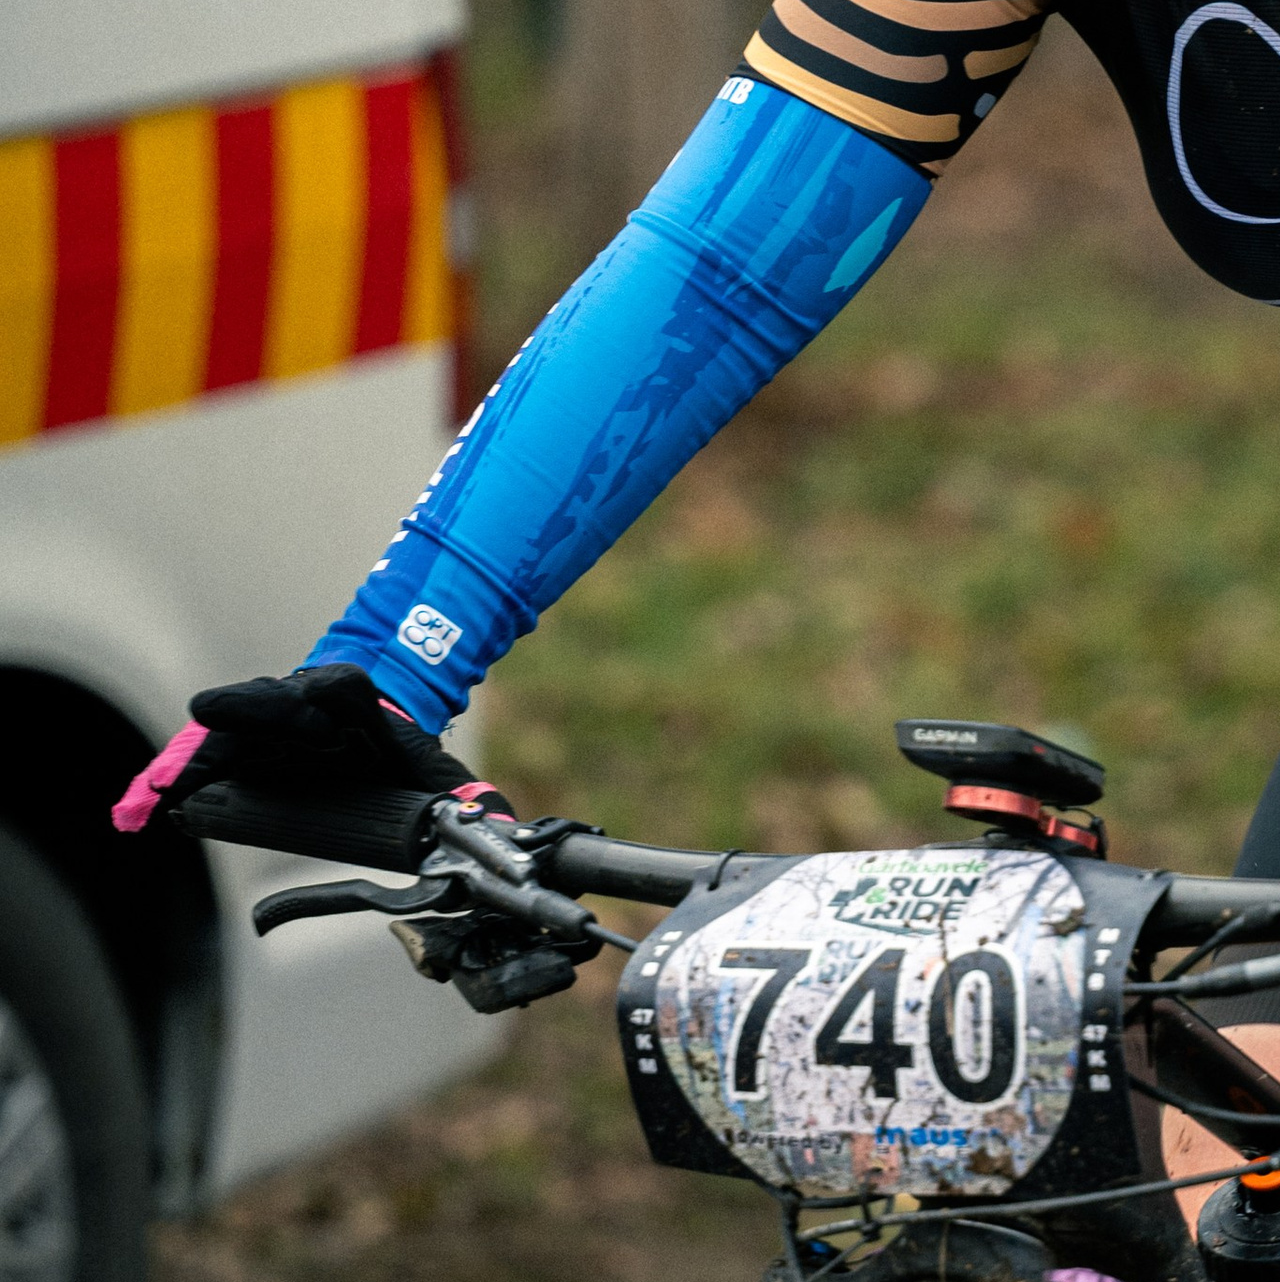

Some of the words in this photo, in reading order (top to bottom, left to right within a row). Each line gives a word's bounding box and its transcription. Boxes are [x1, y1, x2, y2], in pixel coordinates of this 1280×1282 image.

[914, 728, 978, 743] GARMIN
[888, 877, 981, 898] RUN
[870, 900, 969, 920] RIDE
[714, 944, 1020, 1106] 740
[875, 1126, 969, 1147] maus
